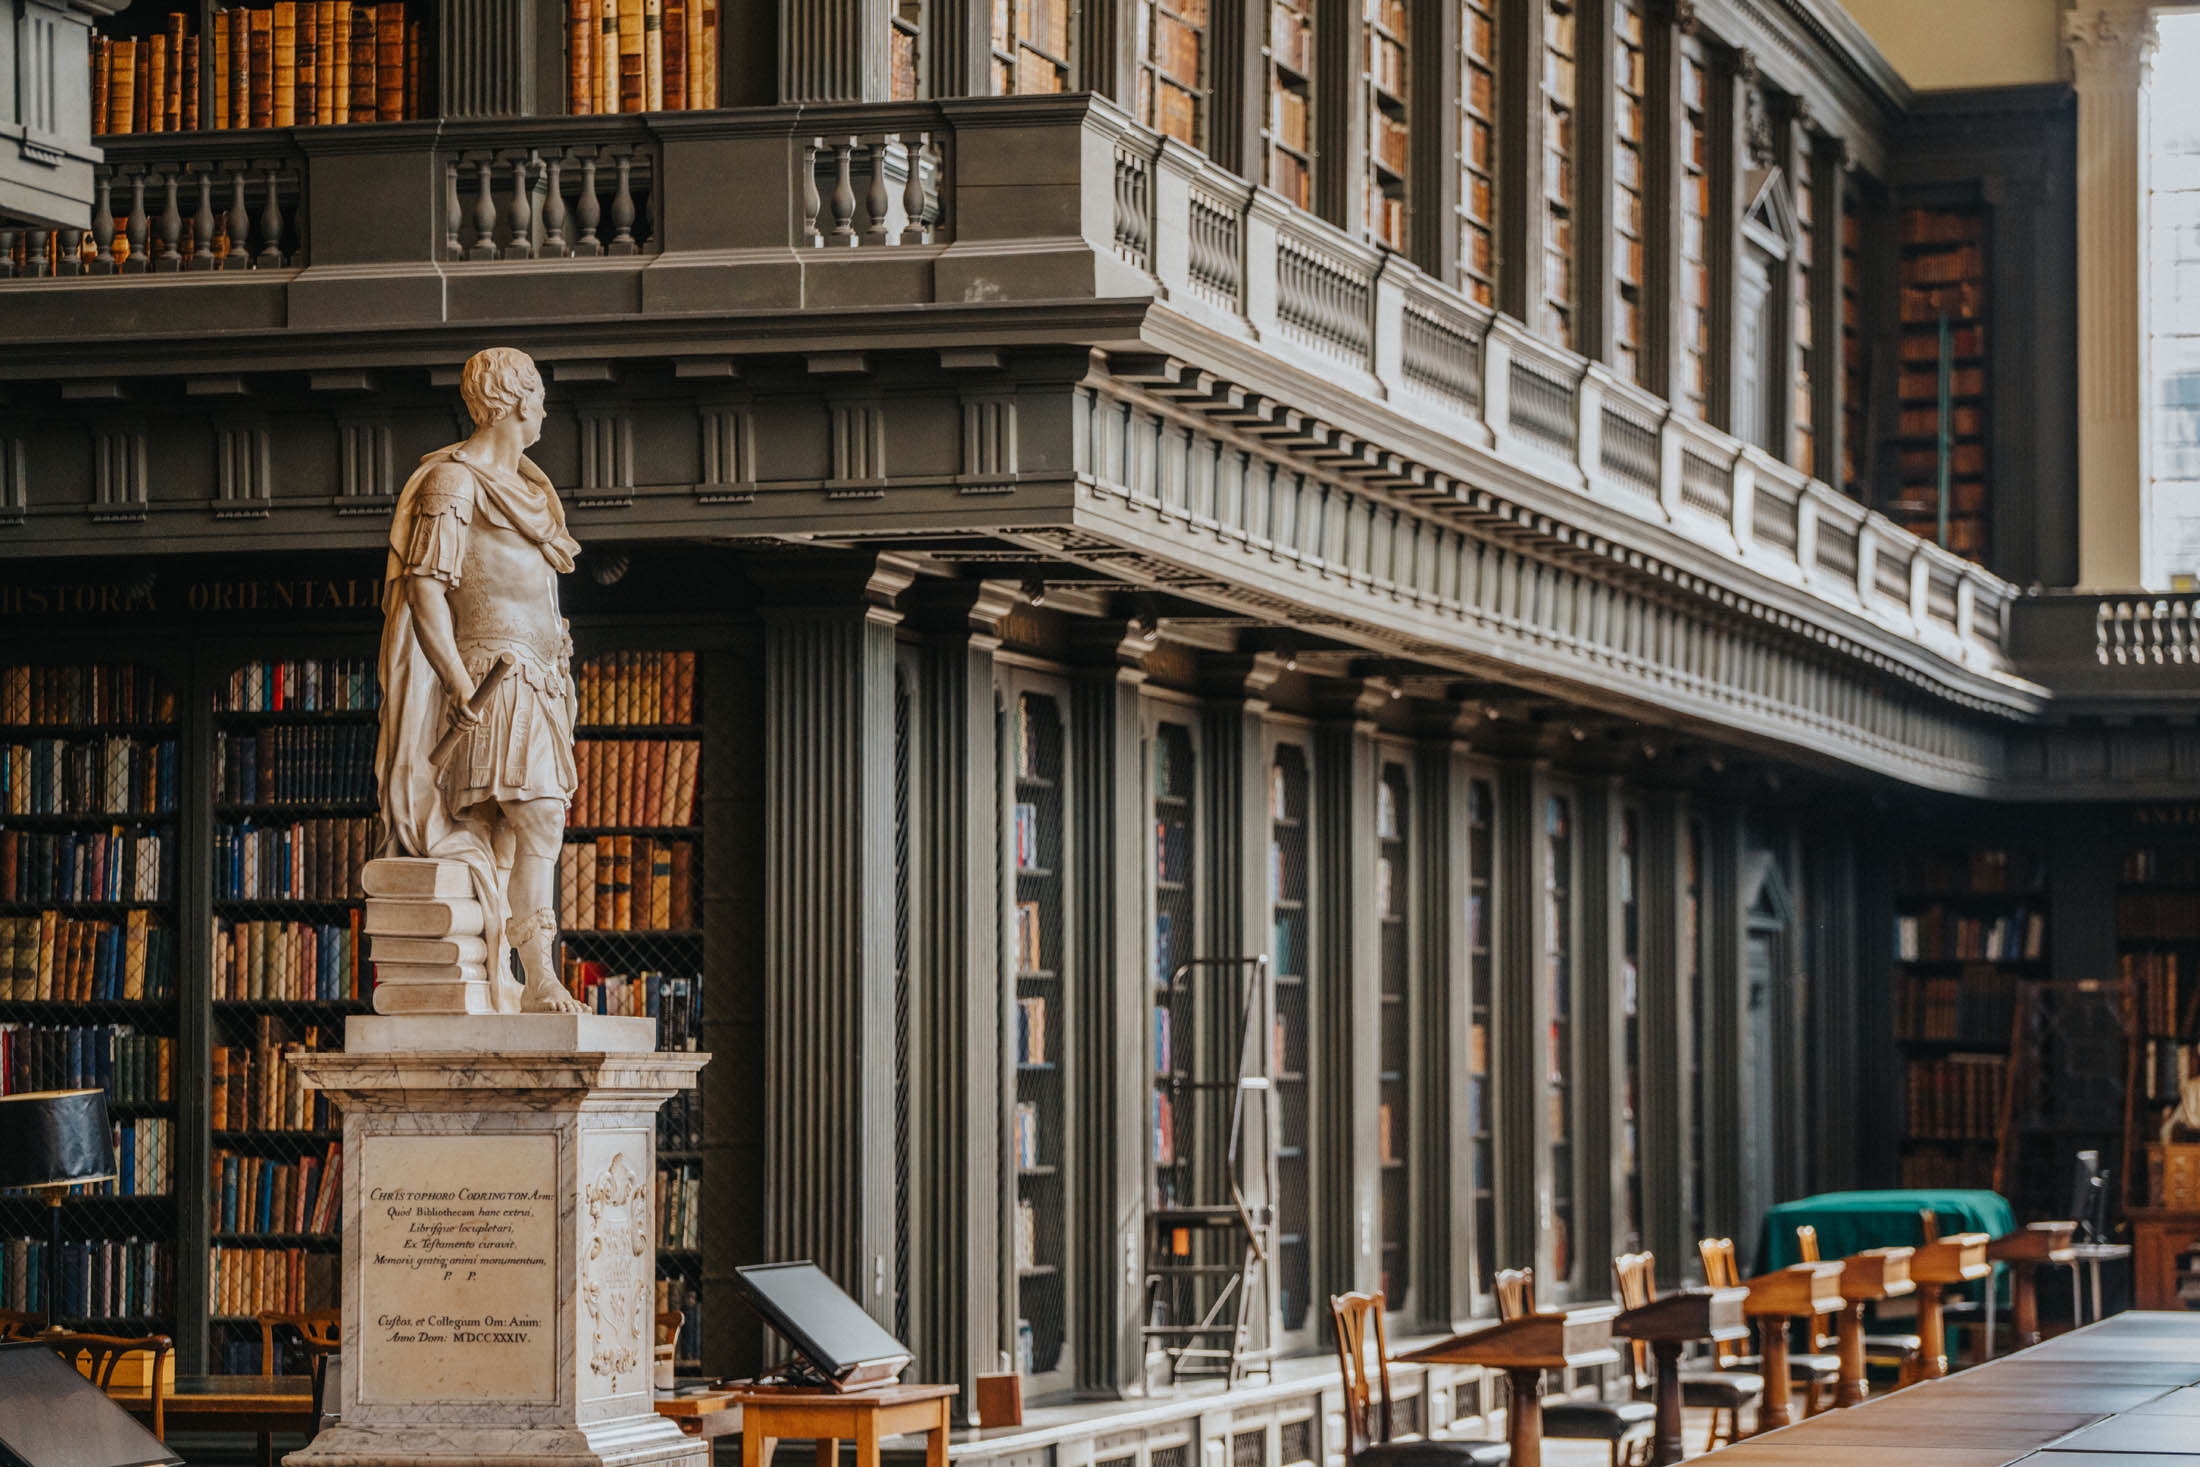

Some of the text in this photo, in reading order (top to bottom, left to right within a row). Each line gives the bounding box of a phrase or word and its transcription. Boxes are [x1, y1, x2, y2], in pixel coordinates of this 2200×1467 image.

[187, 578, 381, 612] ORIENTALI
[458, 1187, 527, 1201] CODRINGTON
[416, 1206, 475, 1217] Bibliothecam
[403, 1239, 418, 1249] Ex
[443, 1271, 477, 1281] P. P.
[415, 1317, 426, 1327] et
[427, 1315, 480, 1330] Collegium
[386, 1331, 416, 1343] Anno
